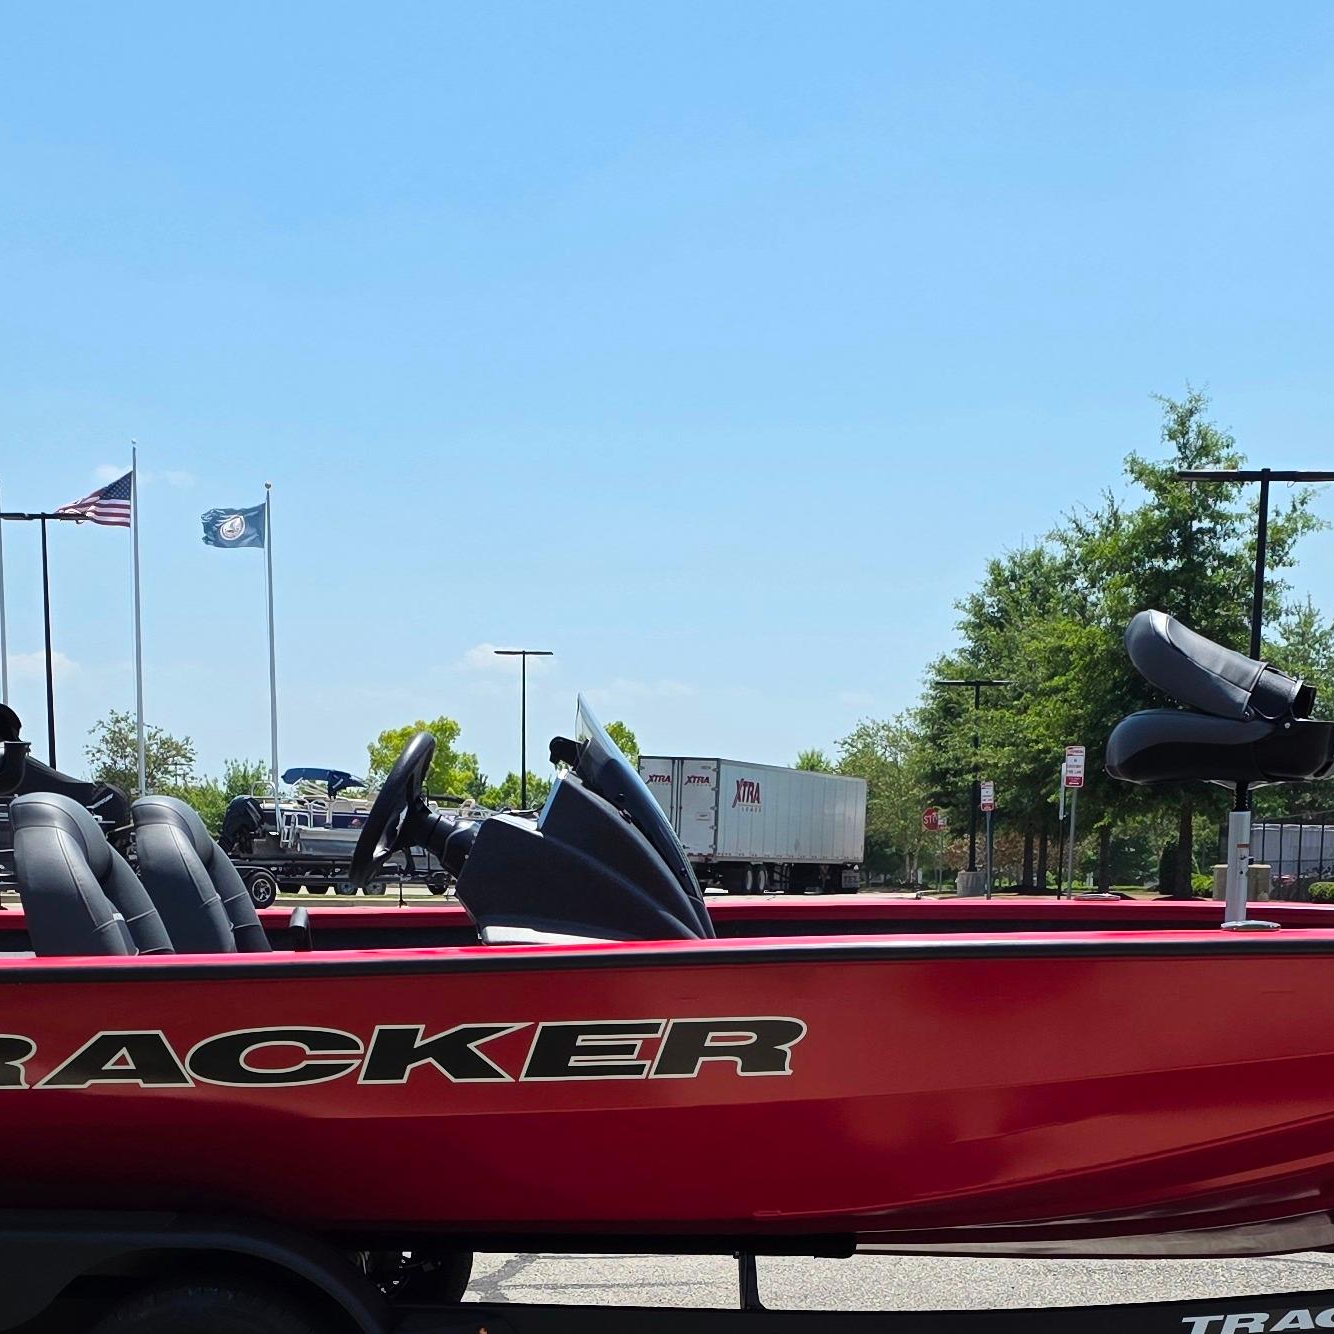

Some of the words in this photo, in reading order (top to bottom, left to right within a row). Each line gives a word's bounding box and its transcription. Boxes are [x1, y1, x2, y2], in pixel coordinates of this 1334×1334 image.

[645, 774, 671, 784] XTRA
[684, 775, 710, 785] XTRA
[731, 778, 760, 808] XTRA
